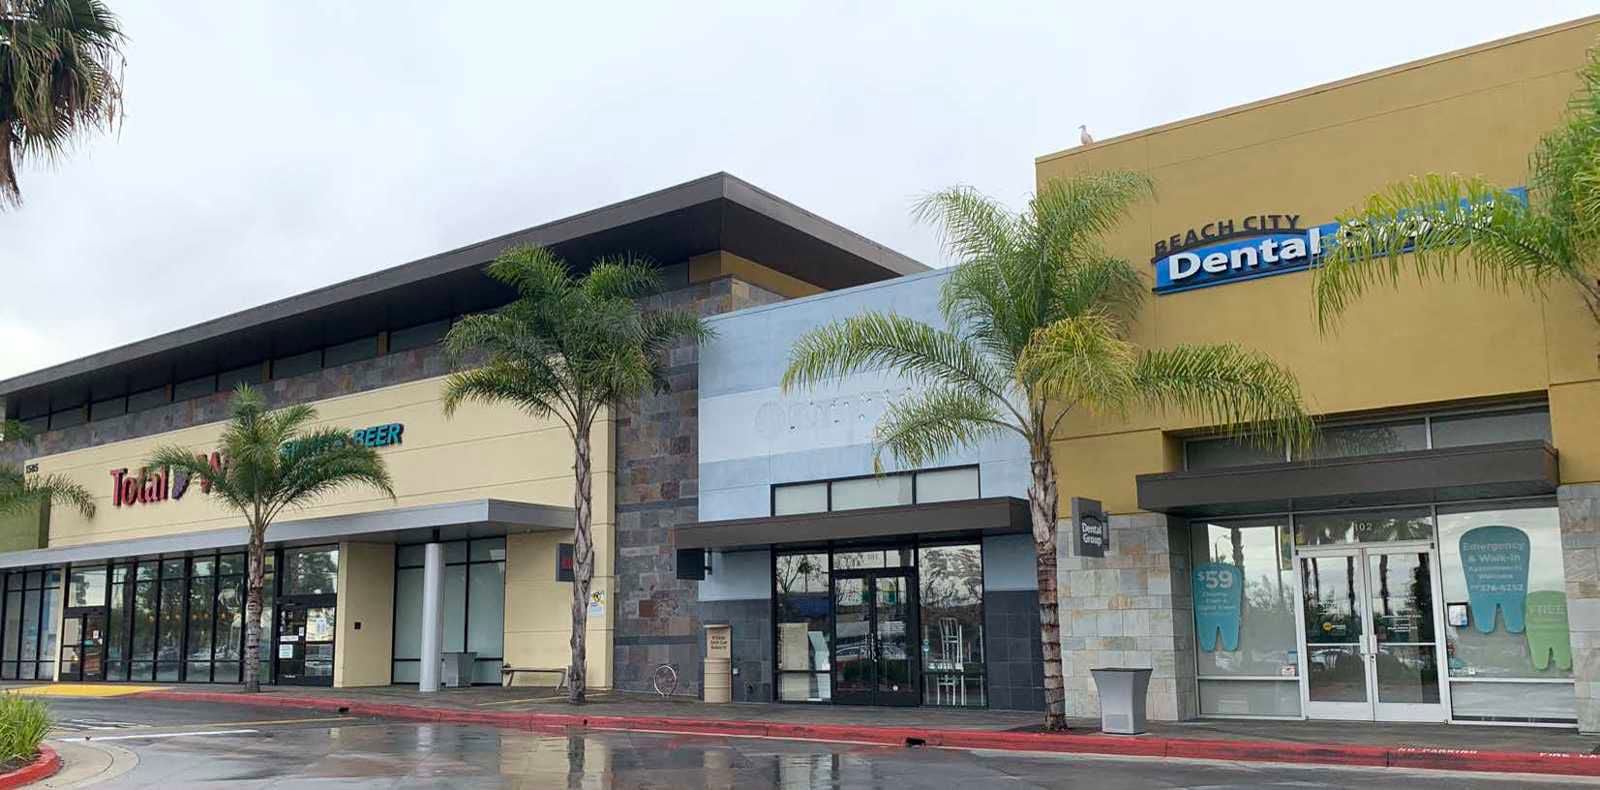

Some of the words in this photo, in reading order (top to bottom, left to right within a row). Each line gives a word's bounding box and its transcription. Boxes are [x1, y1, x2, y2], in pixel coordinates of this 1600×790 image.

[1154, 219, 1234, 257] BEACH
[1243, 214, 1301, 231] CITY
[1169, 227, 1322, 281] Dental
[352, 422, 404, 448] BEER
[110, 463, 169, 507] Total
[1081, 521, 1102, 535] Dental
[1082, 533, 1103, 547] Group
